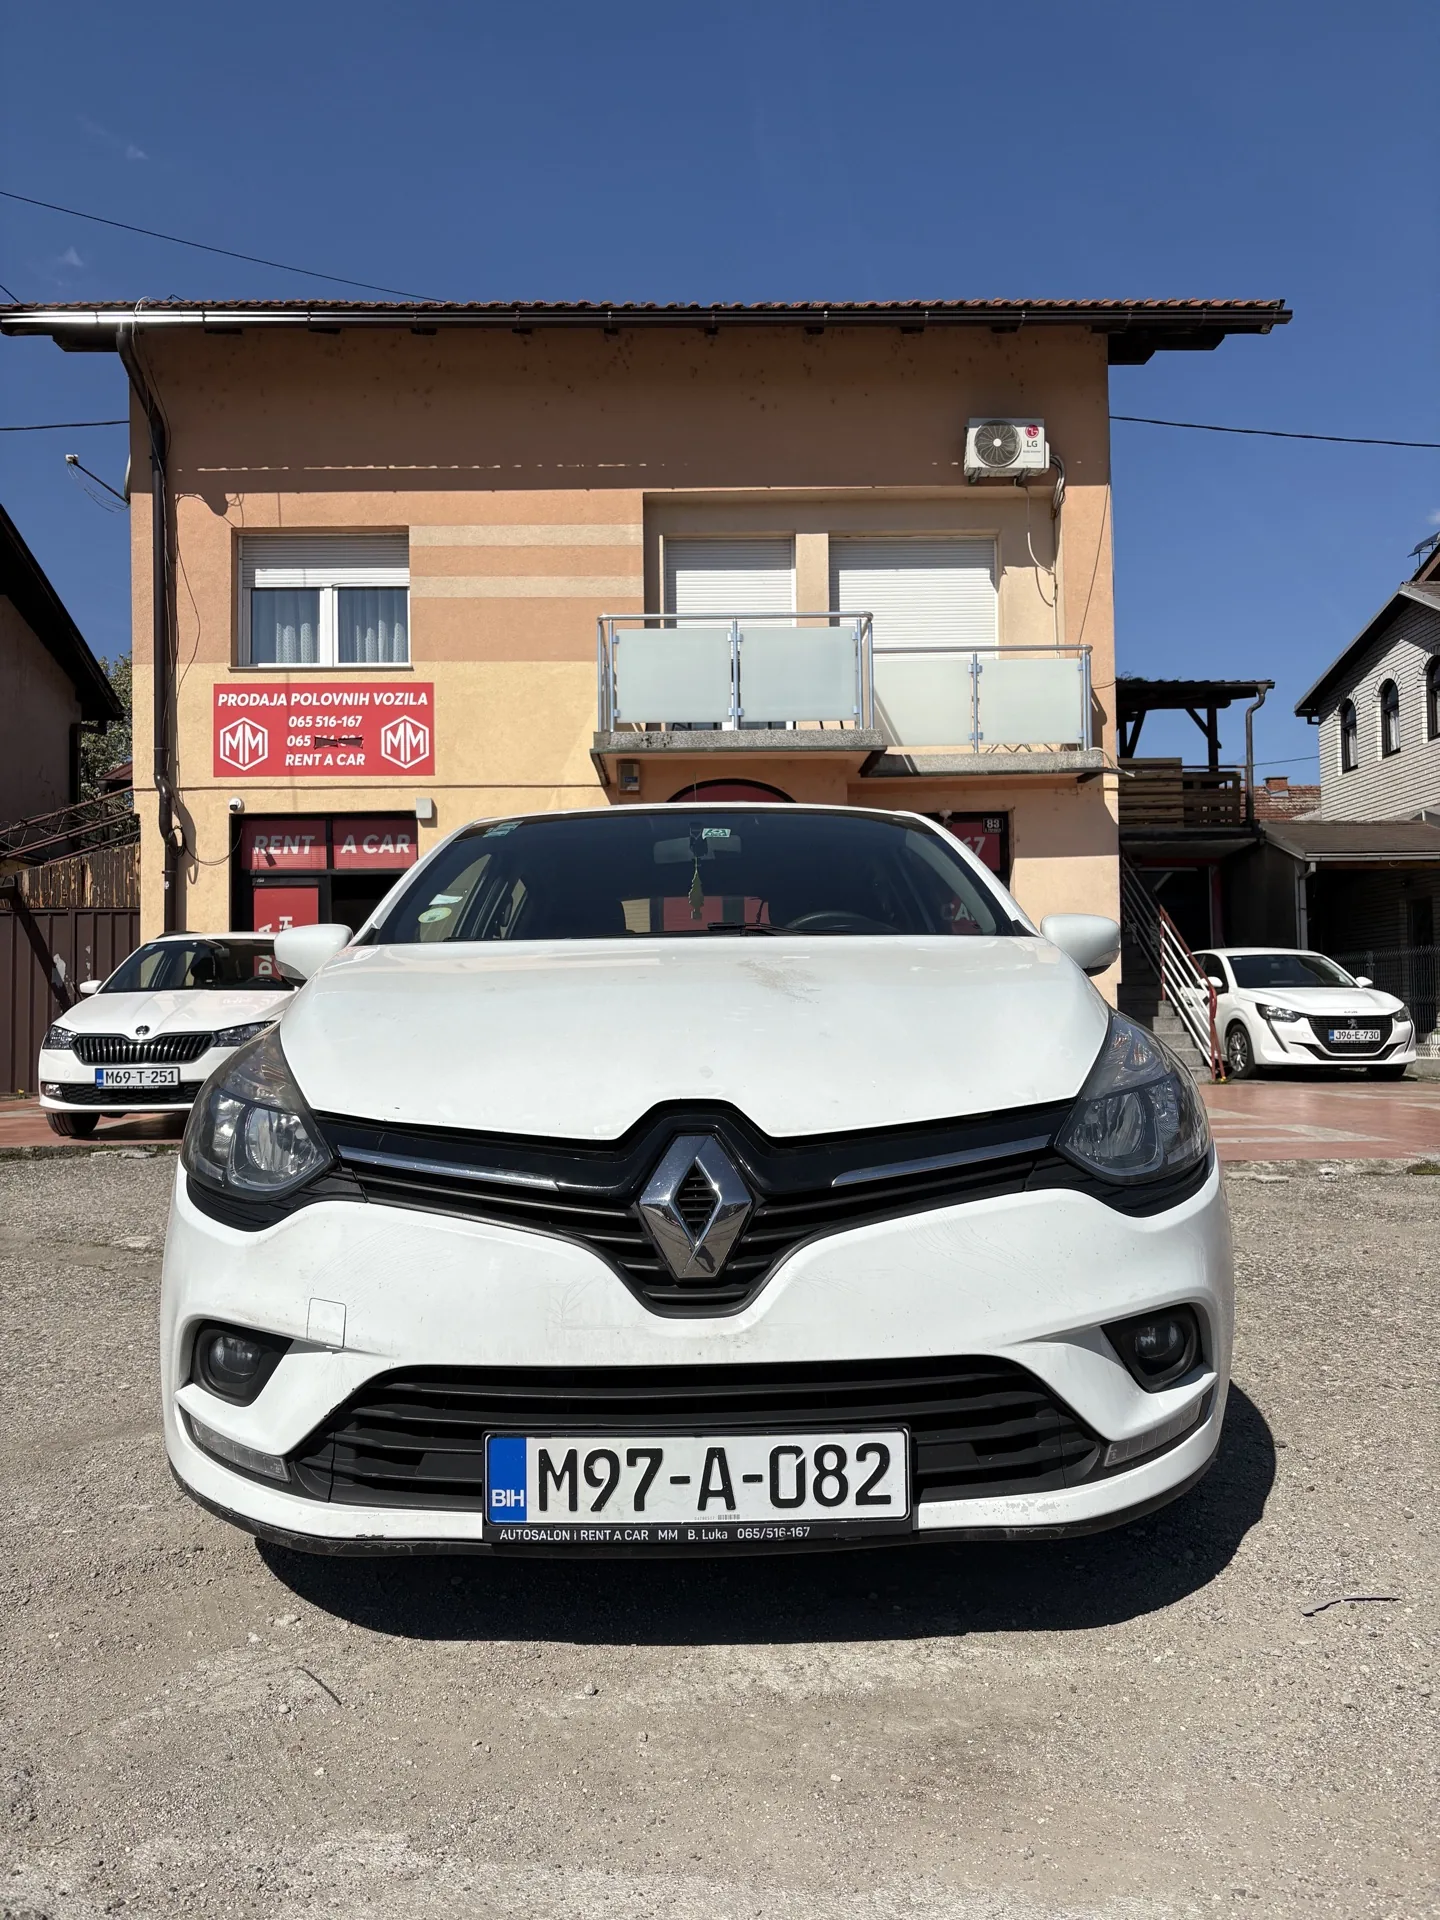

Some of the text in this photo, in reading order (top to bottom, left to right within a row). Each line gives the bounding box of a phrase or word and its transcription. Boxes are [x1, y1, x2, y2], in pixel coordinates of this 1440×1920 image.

[1026, 440, 1038, 448] LG
[217, 692, 429, 707] PRODAJA POLOVNIH VOZILA
[288, 715, 363, 728] 065 516-167
[286, 734, 312, 747] 065
[285, 753, 366, 766] RENT A CAR
[986, 818, 1000, 829] 83
[253, 834, 411, 855] RENT A CAR
[1335, 1031, 1380, 1040] J96-E-730
[105, 1070, 177, 1084] M69-T-251
[537, 1442, 892, 1512] M97-A-082
[491, 1489, 525, 1508] BIH
[499, 1529, 570, 1541] AUTOSALON
[580, 1529, 612, 1541] RENT
[613, 1529, 622, 1541] A
[624, 1529, 649, 1541] CAR
[657, 1529, 679, 1541] MM
[687, 1529, 699, 1540] B.
[702, 1528, 728, 1540] Luka
[737, 1526, 811, 1539] 065/516-167
